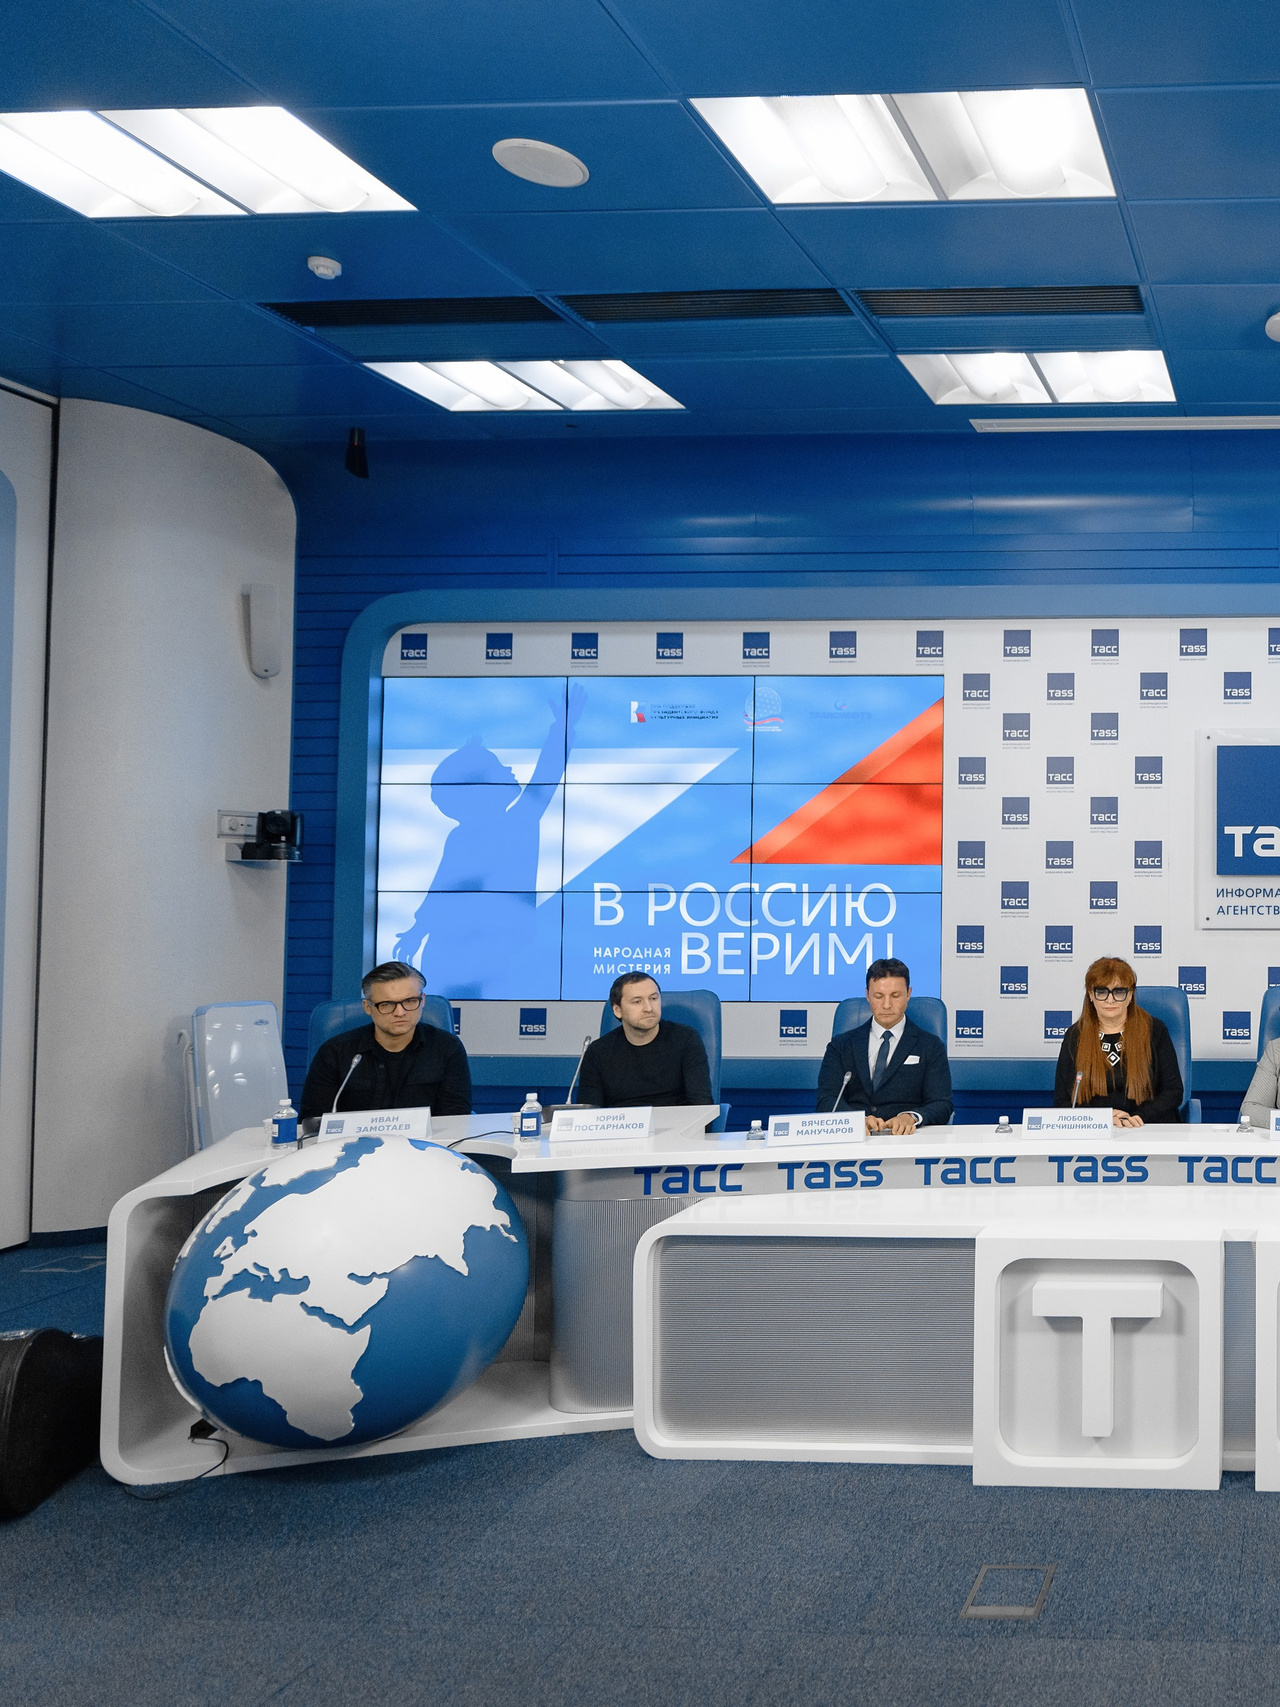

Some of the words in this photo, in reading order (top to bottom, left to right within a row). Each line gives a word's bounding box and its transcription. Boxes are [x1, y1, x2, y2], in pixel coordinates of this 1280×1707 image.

[592, 882, 624, 926] В
[648, 882, 898, 927] РОССИЮ
[594, 947, 672, 959] НАРОДНАЯ
[370, 1116, 399, 1124] ИВАН
[596, 1114, 626, 1122] ЮРИЙ
[801, 1118, 850, 1127] ВЯЧЕСЛАВ
[356, 1124, 411, 1133] ЗАМОТАЕВ
[574, 1122, 645, 1132] ПОСТАРНАКОВ
[796, 1128, 854, 1136] МАНУЧАРОВ
[778, 1160, 884, 1190] TASS
[915, 1156, 1016, 1186] ТАСС
[1048, 1156, 1150, 1184] TASS
[1178, 1156, 1278, 1184] ТАСС
[634, 1164, 744, 1196] ТАСС
